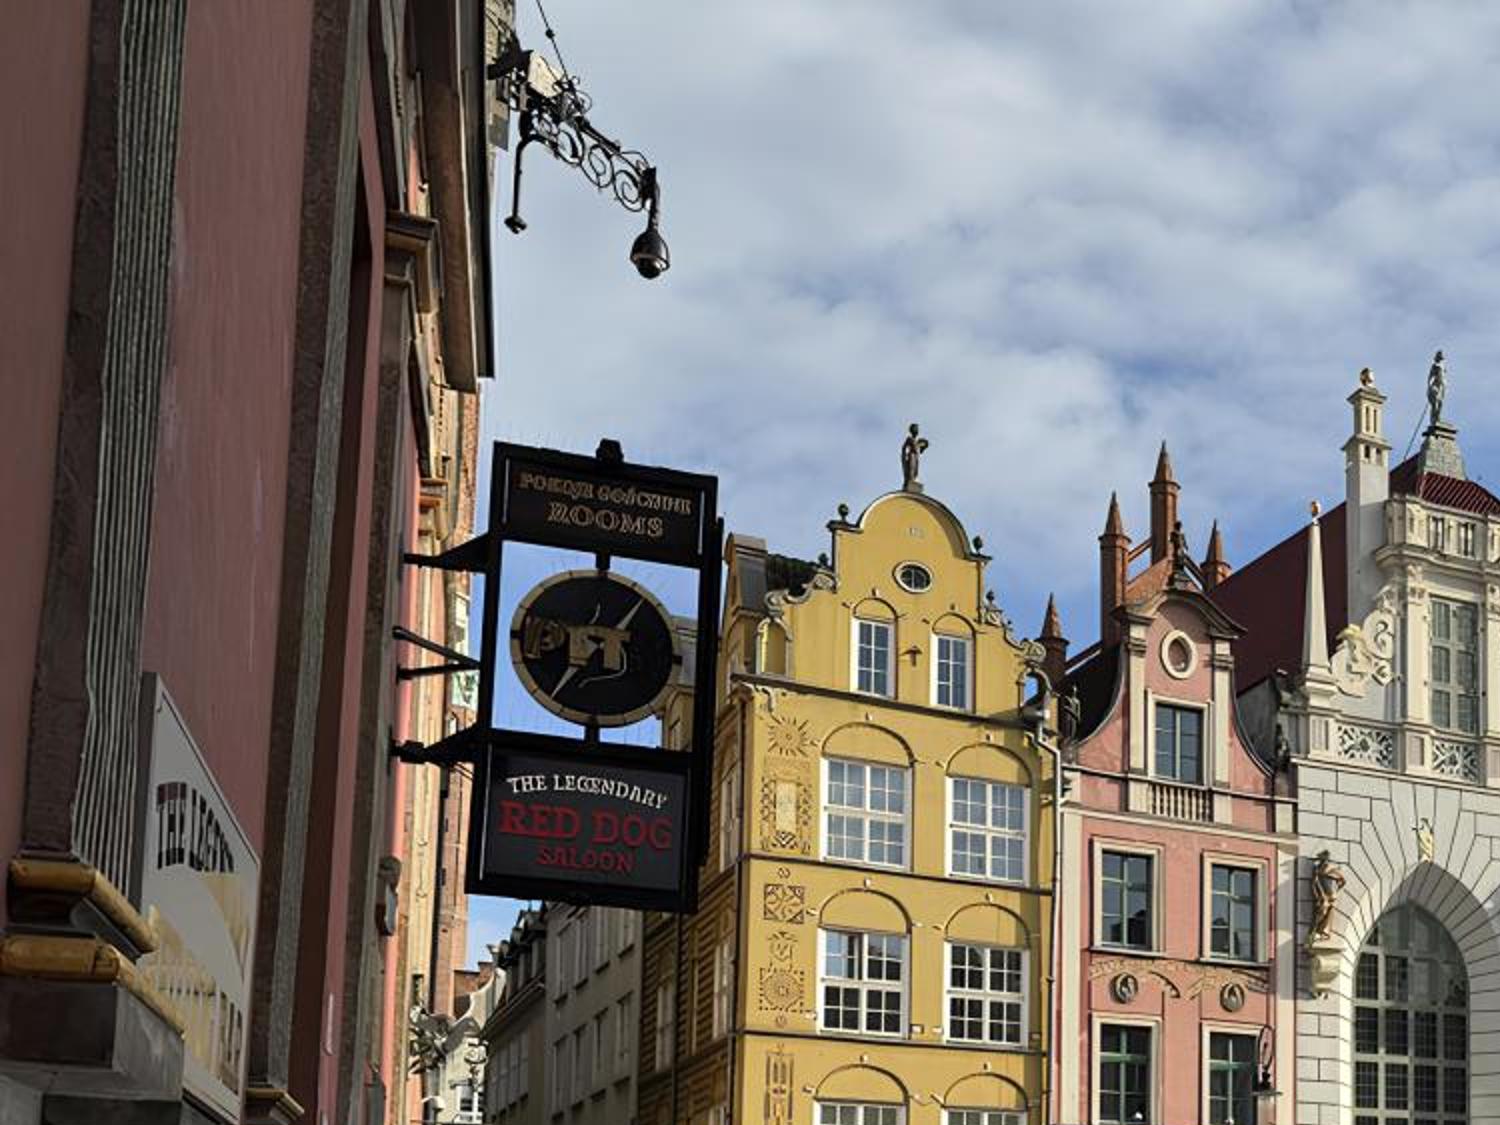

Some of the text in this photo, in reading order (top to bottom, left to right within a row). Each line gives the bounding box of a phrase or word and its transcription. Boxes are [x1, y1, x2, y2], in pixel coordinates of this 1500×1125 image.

[547, 501, 665, 538] ROOMS
[506, 773, 668, 809] THE LEGENDARY
[498, 800, 673, 850] RED DOG
[536, 845, 638, 874] SALOON
